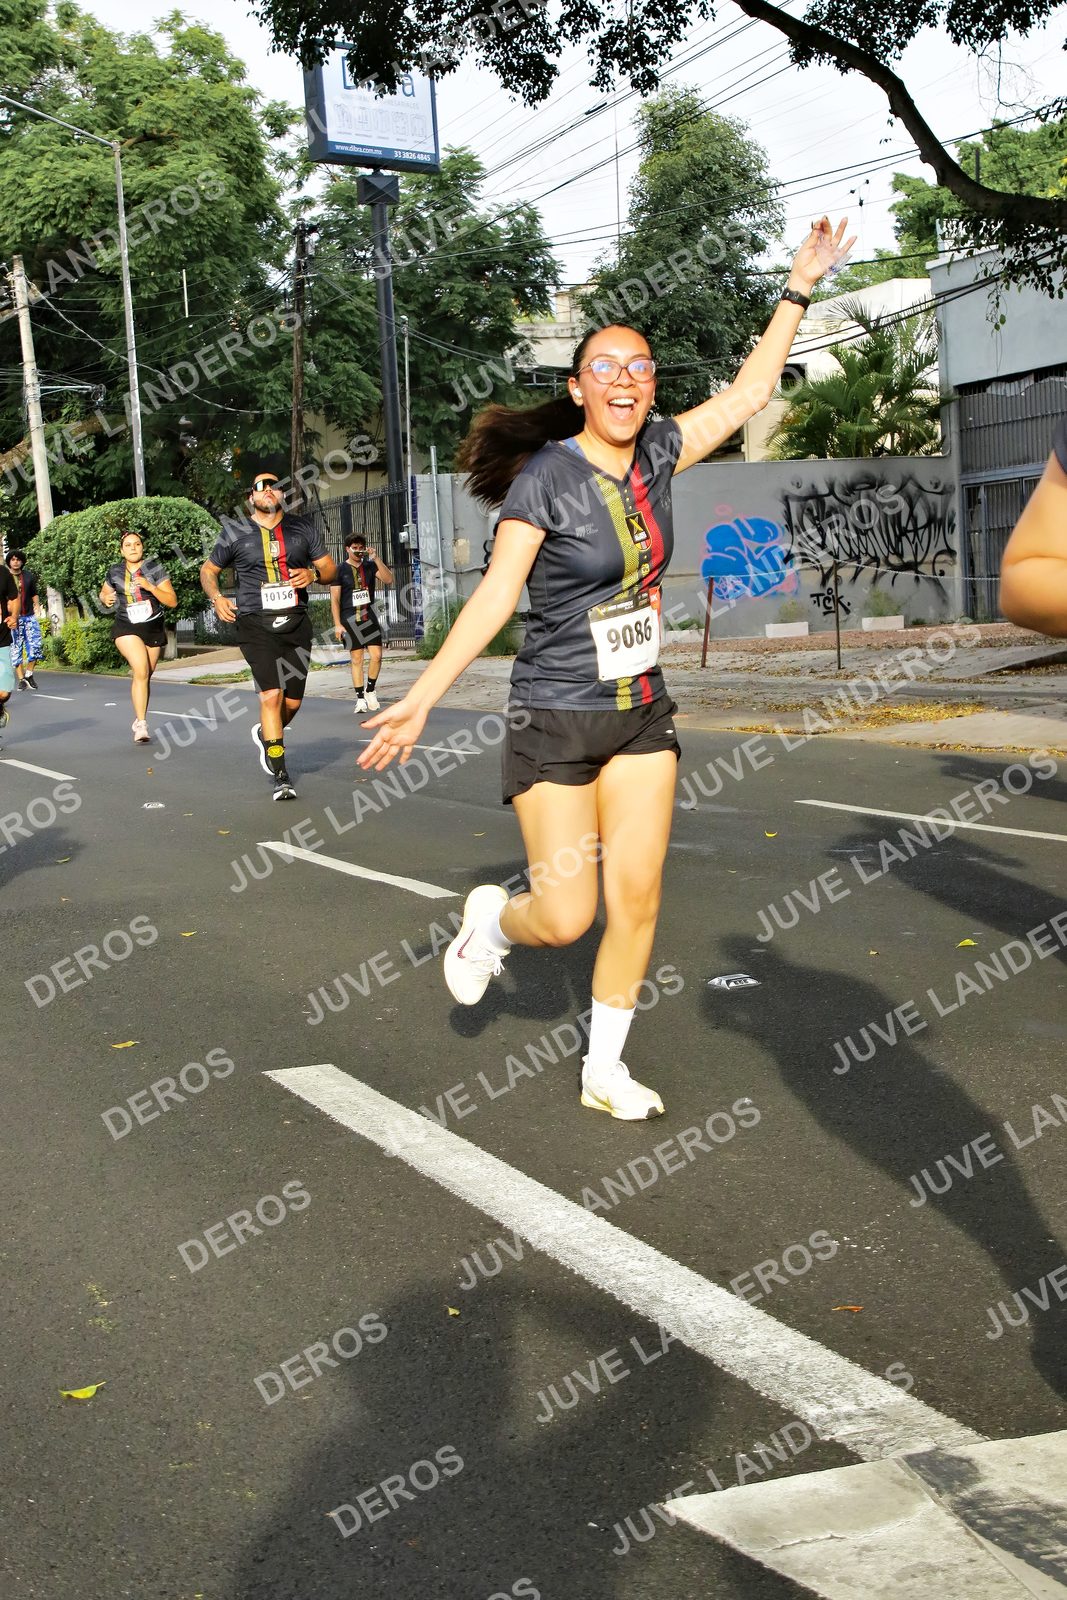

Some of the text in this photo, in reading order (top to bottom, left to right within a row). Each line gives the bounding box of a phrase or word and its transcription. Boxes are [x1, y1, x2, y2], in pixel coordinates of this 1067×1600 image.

[335, 144, 382, 155] www.dibra.com.mx
[394, 150, 431, 161] 33 3826 4845
[264, 589, 293, 602] 10156
[606, 615, 653, 653] 9086
